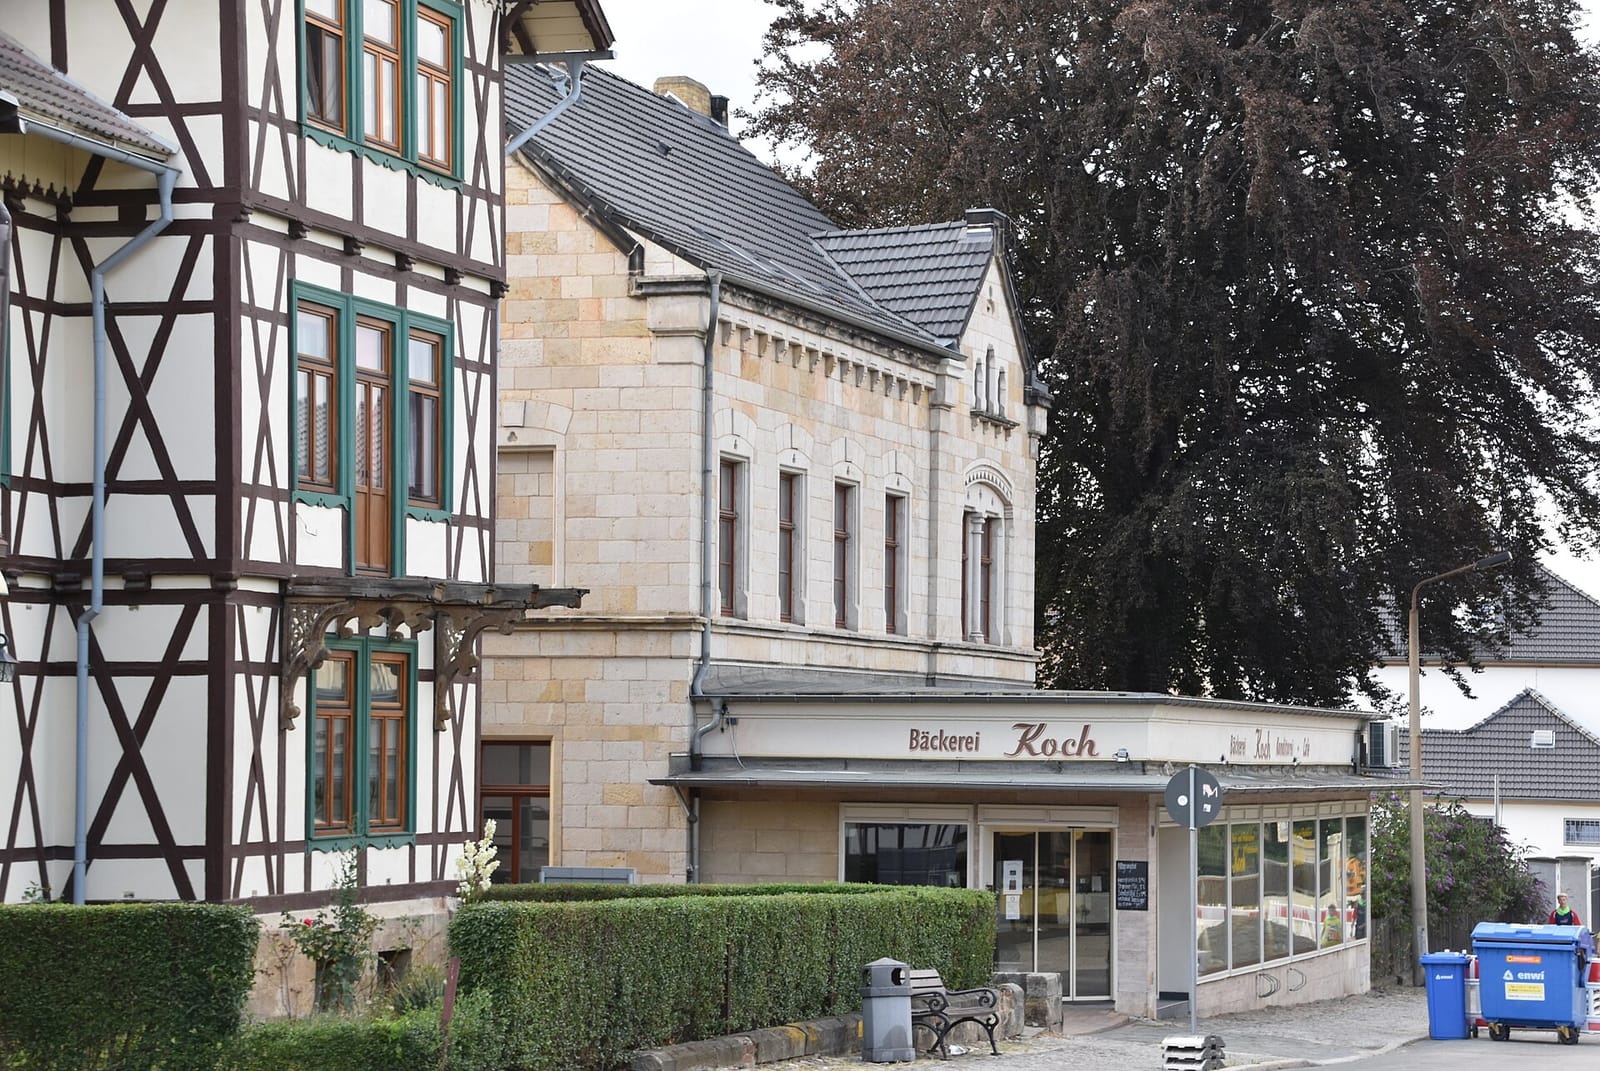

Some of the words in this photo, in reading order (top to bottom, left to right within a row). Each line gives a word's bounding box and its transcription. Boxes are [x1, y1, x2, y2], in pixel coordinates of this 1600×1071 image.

[909, 728, 980, 752] Bäckerei
[1004, 723, 1099, 757] Koch
[1253, 728, 1271, 760] Koch
[1517, 970, 1545, 980] enwi
